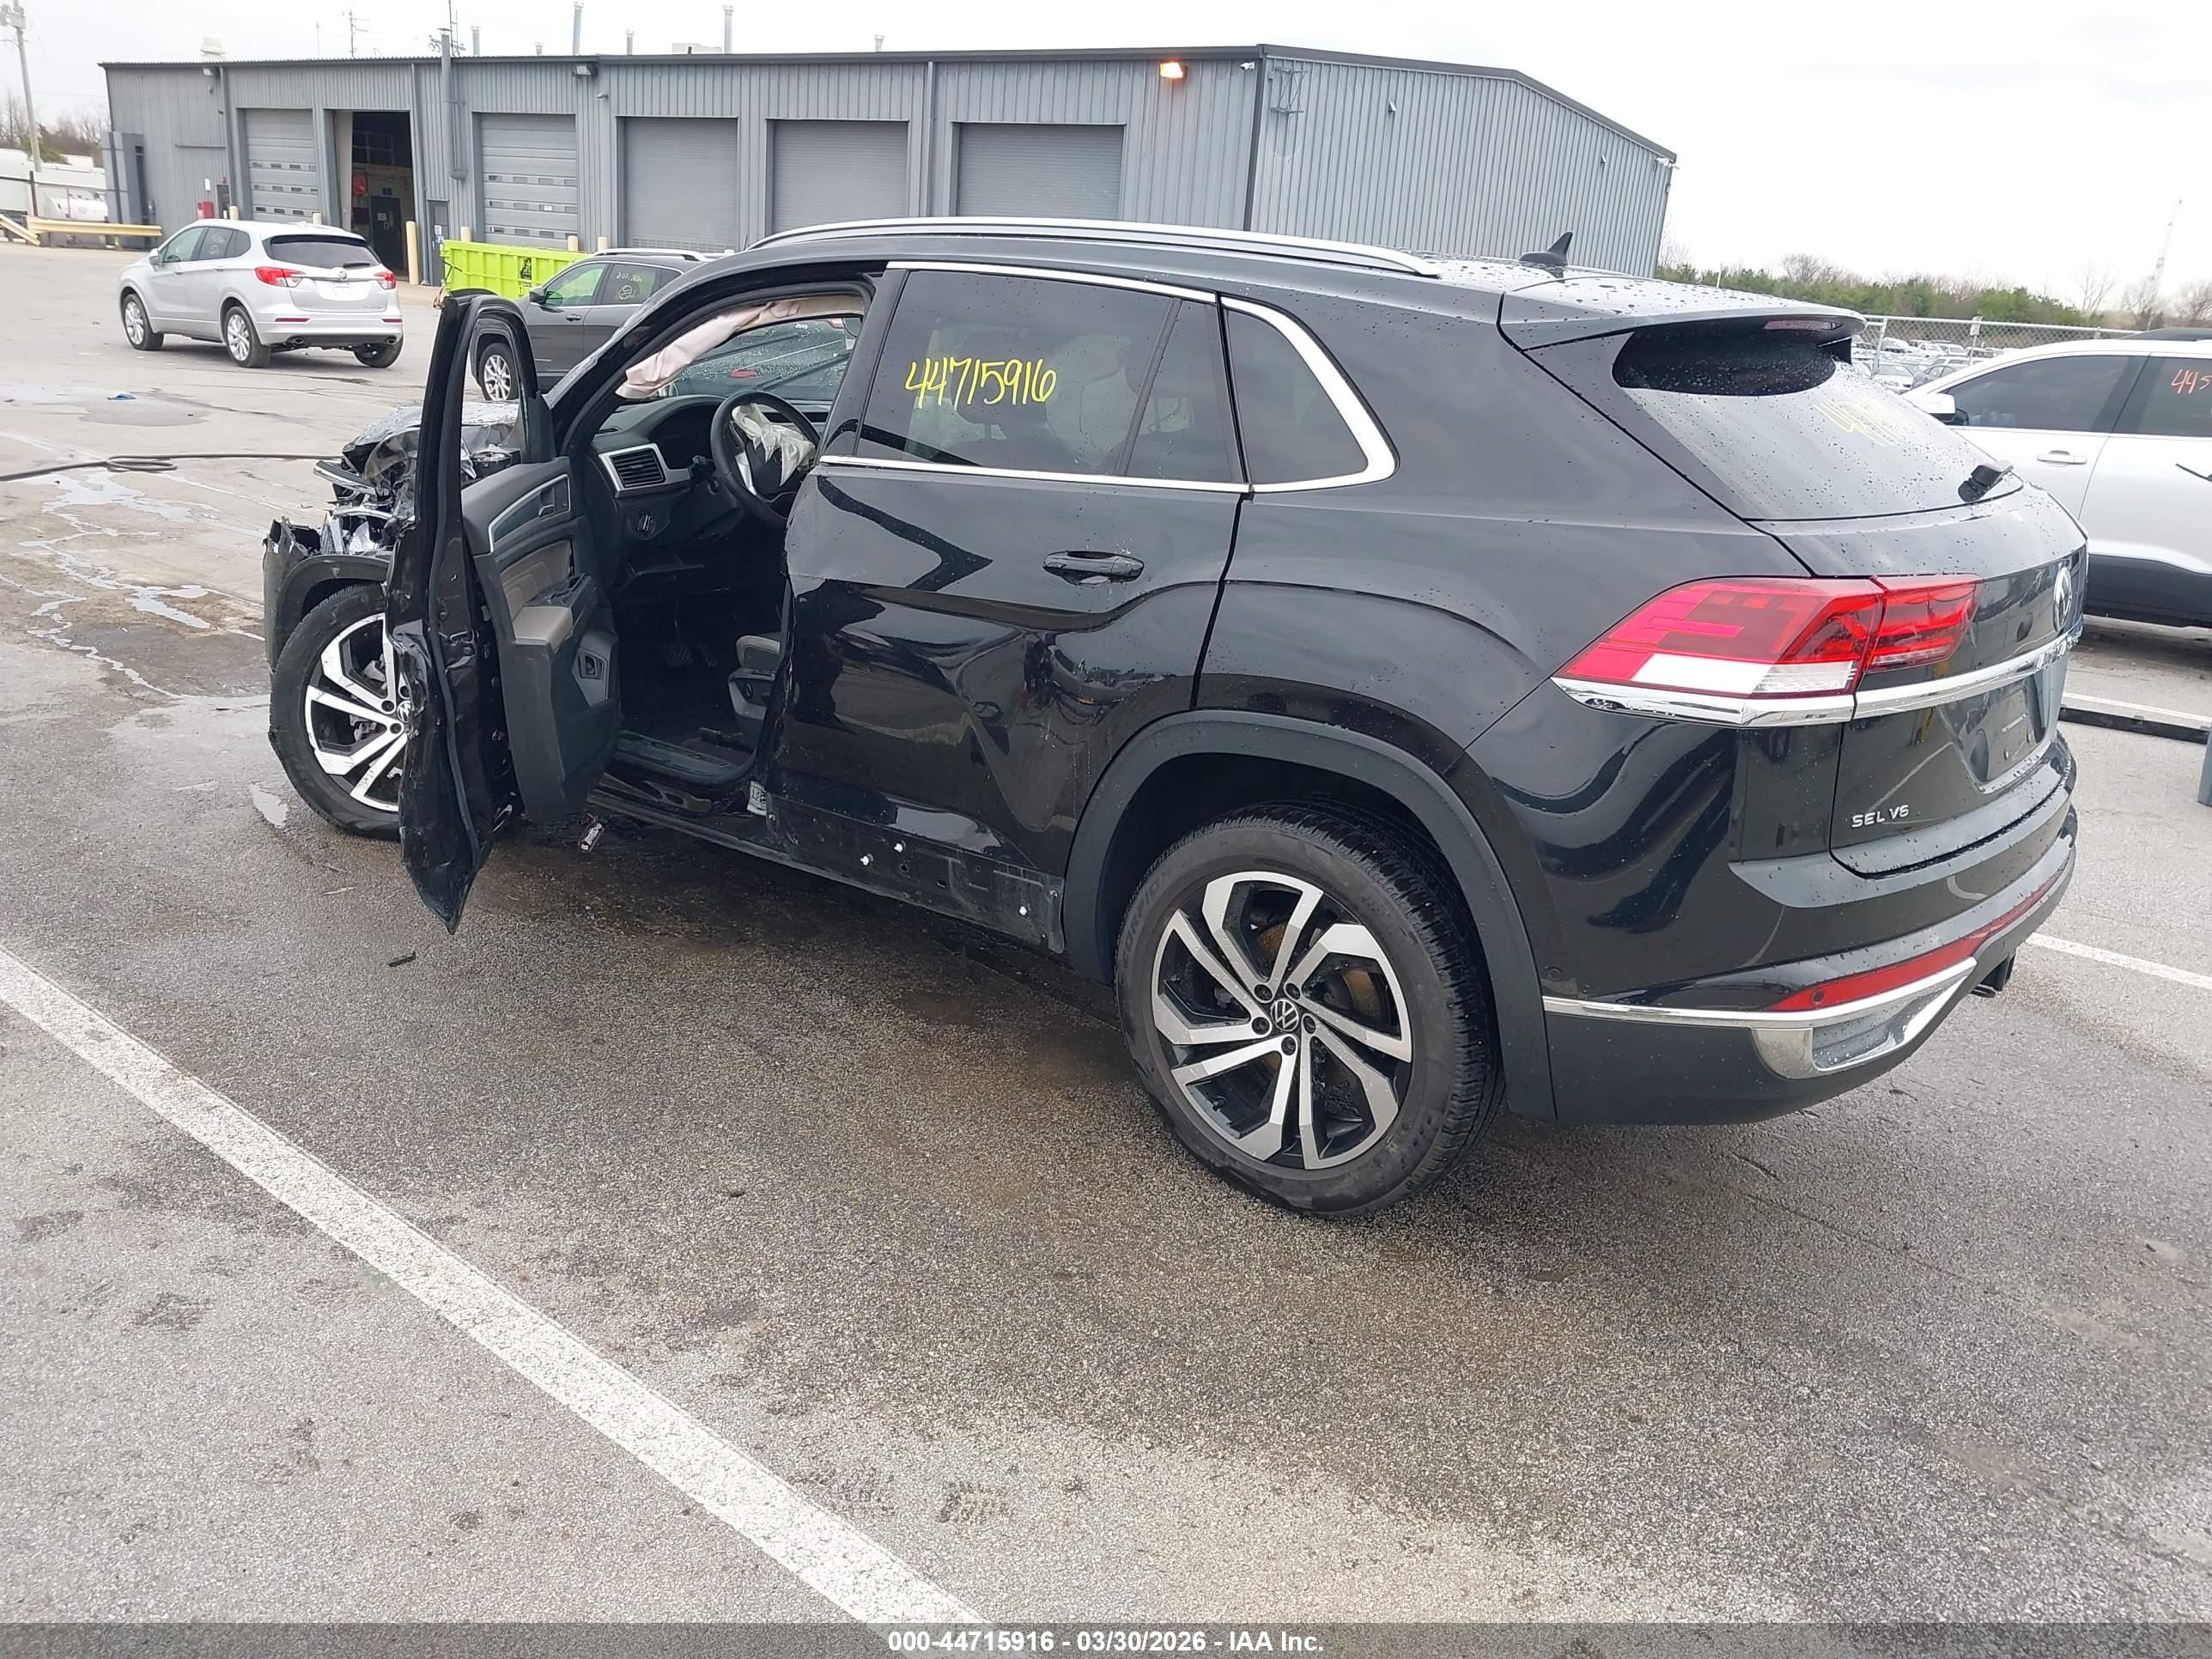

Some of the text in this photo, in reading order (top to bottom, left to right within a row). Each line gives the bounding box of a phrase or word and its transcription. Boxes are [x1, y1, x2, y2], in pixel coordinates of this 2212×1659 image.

[904, 356, 1058, 412] 44715916
[1851, 805, 1910, 829] SEL V6
